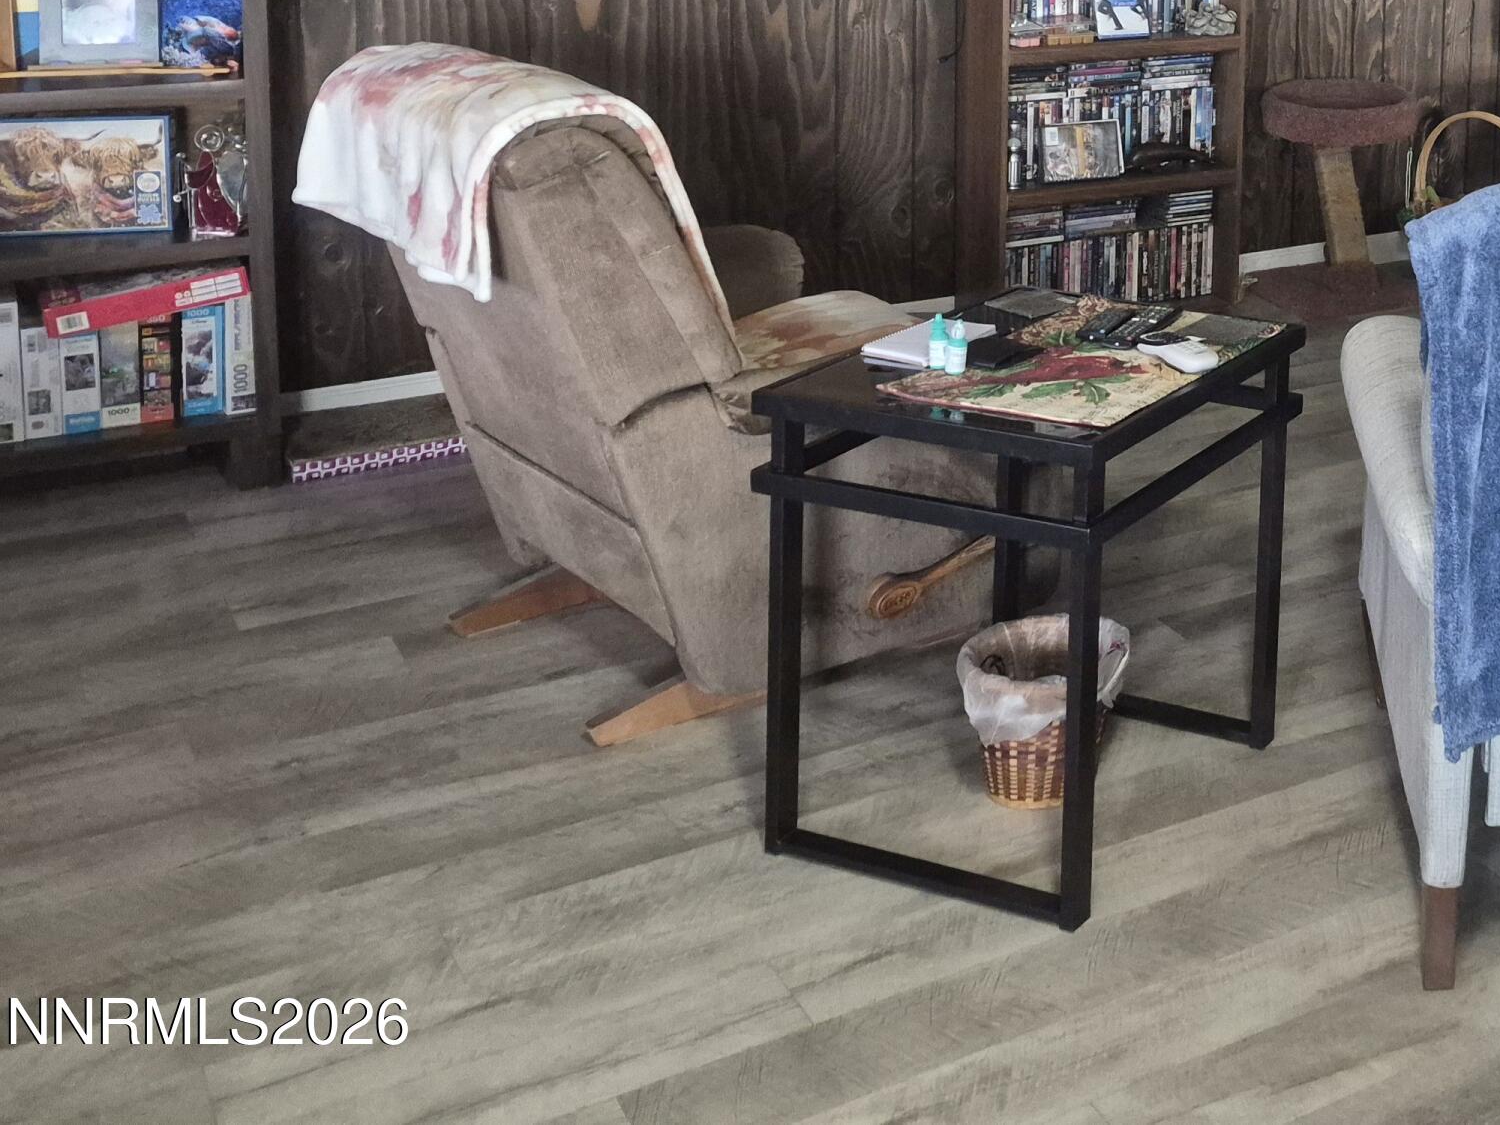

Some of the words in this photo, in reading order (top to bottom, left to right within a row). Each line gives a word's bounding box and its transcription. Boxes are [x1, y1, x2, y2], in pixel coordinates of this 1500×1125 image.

[187, 308, 209, 317] 1000
[233, 363, 248, 393] 1000
[108, 407, 130, 416] 1000
